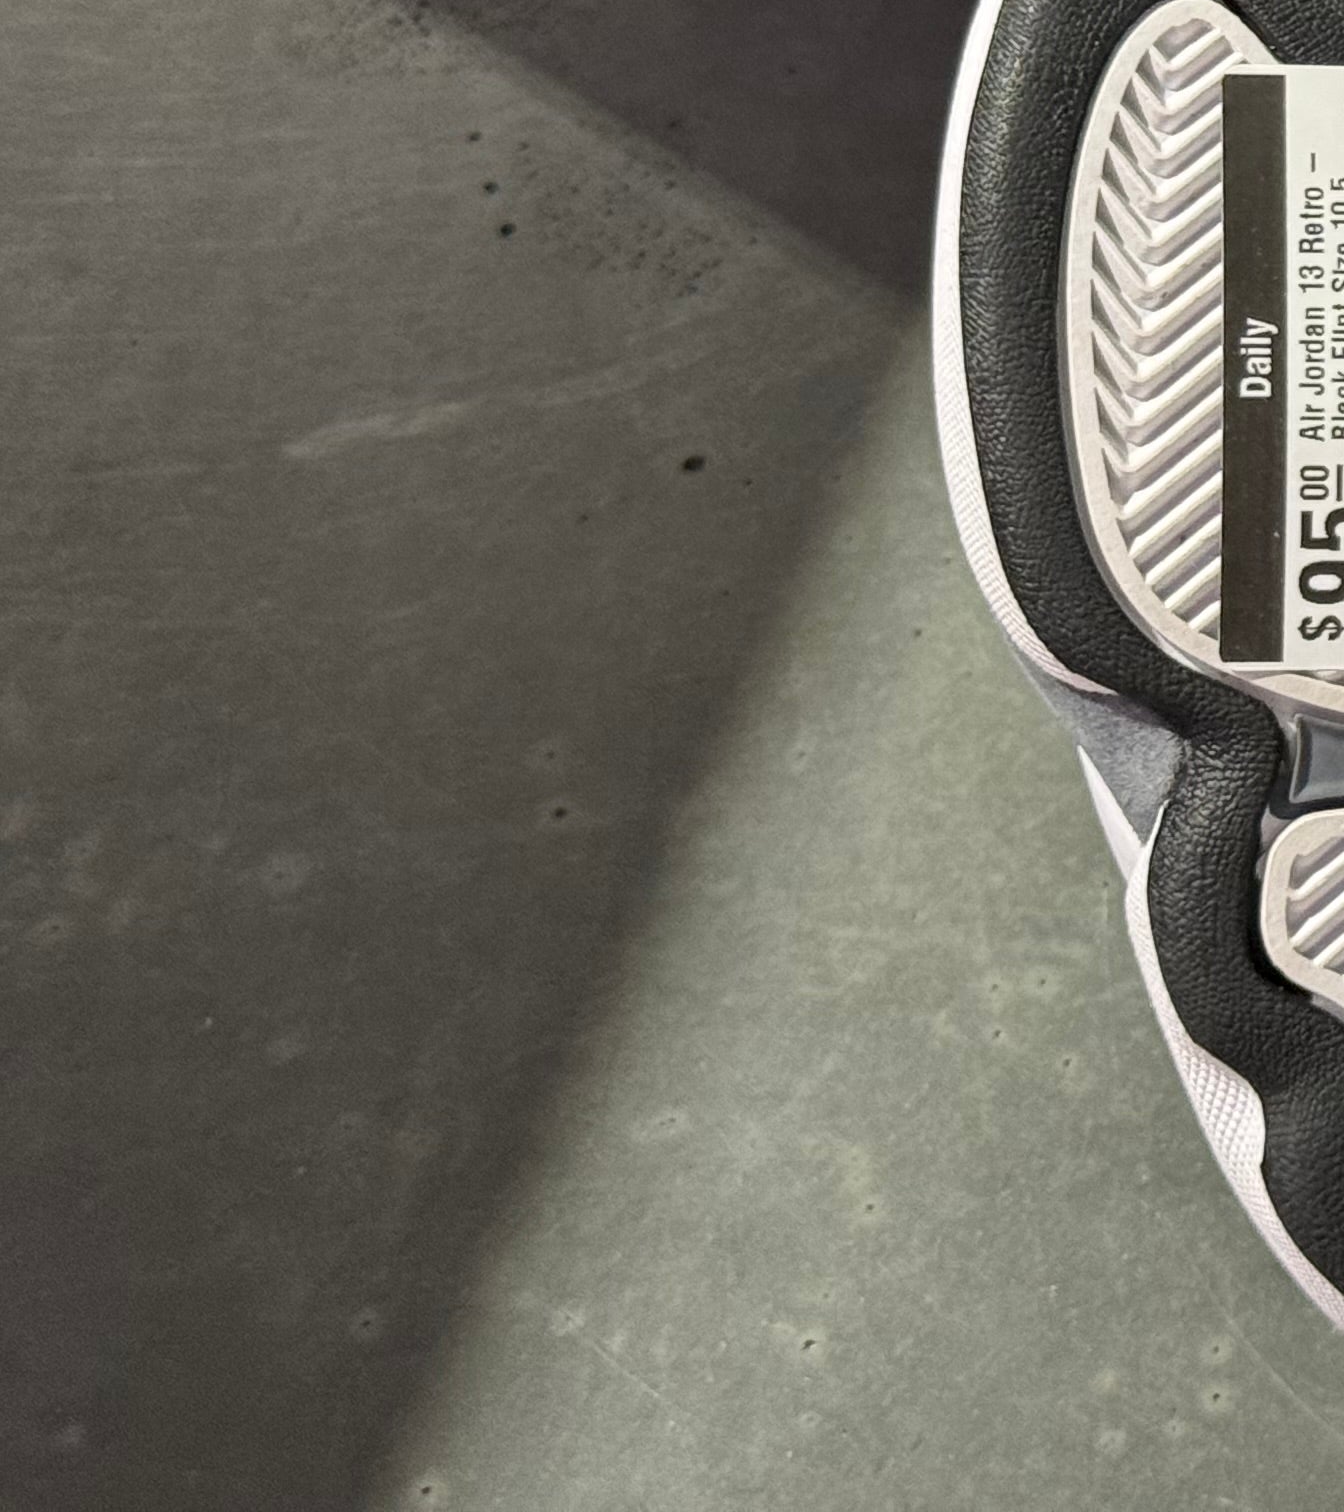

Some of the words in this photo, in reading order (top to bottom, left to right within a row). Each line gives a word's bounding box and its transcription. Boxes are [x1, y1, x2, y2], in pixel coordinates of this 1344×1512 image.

[1298, 186, 1325, 254] Retro
[1298, 264, 1325, 294] 13
[1239, 316, 1279, 399] Daily
[1298, 306, 1326, 396] Jordan
[1299, 405, 1326, 442] Air
